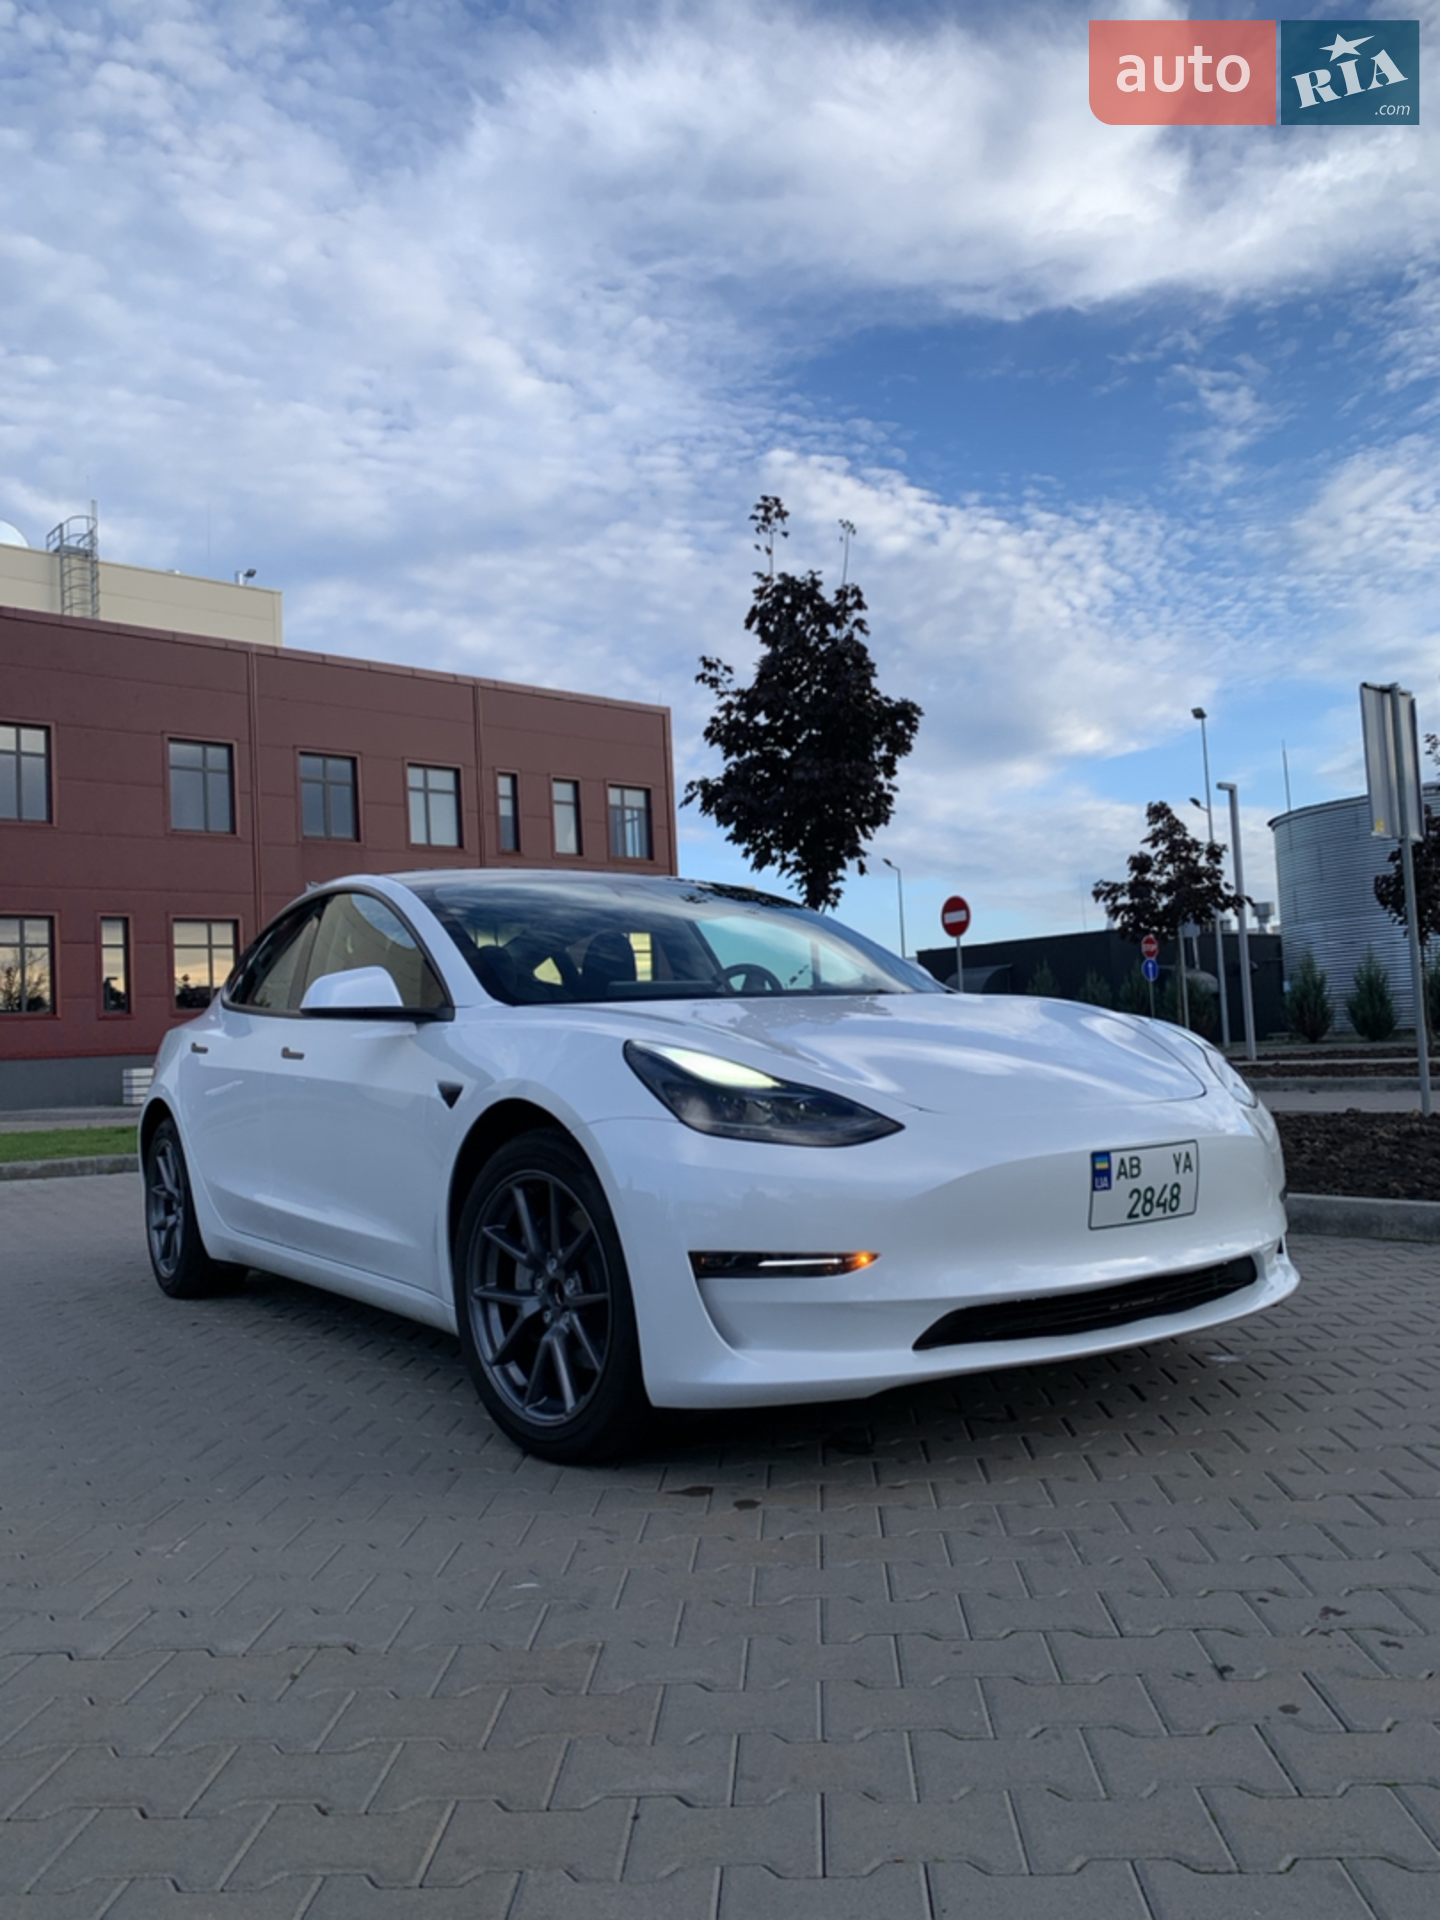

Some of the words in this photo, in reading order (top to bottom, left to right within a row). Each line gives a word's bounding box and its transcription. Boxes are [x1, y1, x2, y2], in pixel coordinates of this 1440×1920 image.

[1116, 1156, 1142, 1180] AB
[1172, 1152, 1193, 1175] YA
[1094, 1176, 1109, 1189] UA
[1127, 1182, 1181, 1219] 2848
